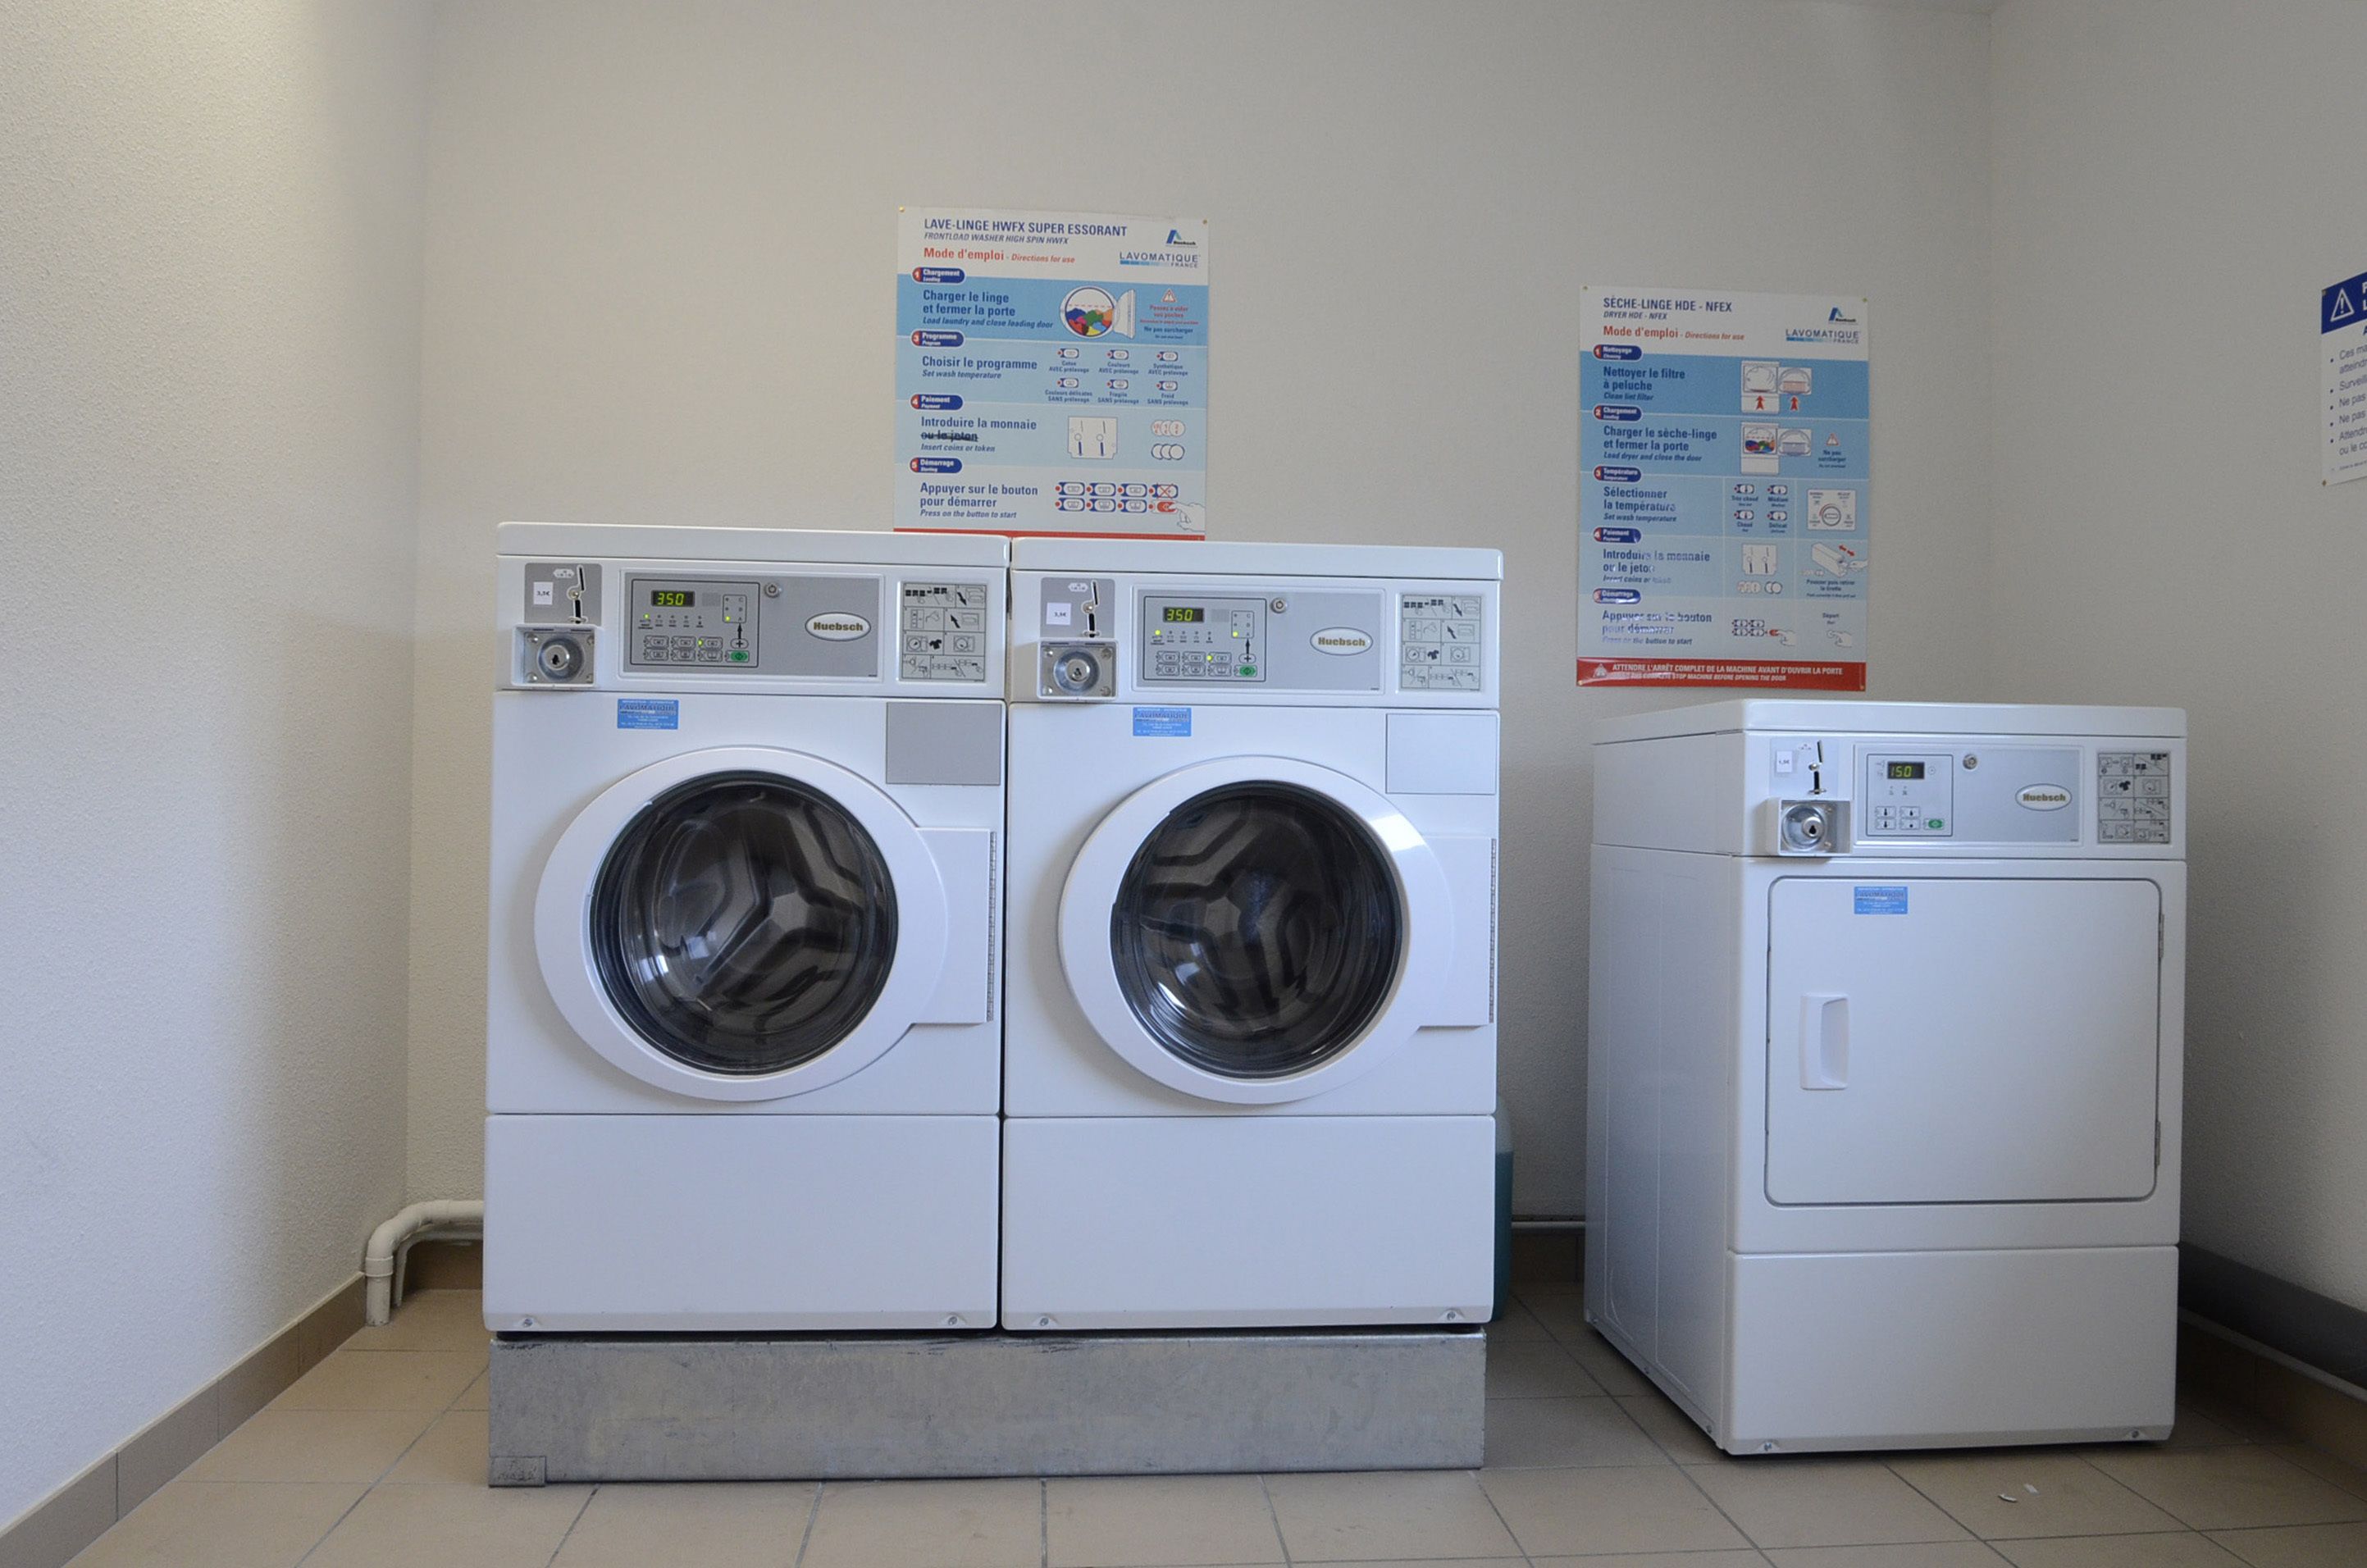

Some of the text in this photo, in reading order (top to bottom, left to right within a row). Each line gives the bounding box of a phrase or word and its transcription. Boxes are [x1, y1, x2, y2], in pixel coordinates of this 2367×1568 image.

[924, 218, 1128, 236] LAVE-LINGE HWFX SUPER ESSORANT
[924, 233, 969, 241] FRONTLOAD
[971, 234, 1004, 242] WASHER
[1006, 235, 1024, 243] HIGH
[924, 248, 955, 258] Mode
[958, 248, 1004, 262] d'emploi
[1011, 253, 1049, 262] Directions
[1051, 255, 1061, 263] for
[1120, 252, 1198, 262] LAVOMATIQUE
[924, 289, 1009, 305] Charger le linge
[1603, 295, 1732, 312] SÈCHE-LINGE HDE NFEX
[923, 303, 1015, 318] et fermer la porte
[1628, 312, 1643, 320] HDE
[923, 317, 941, 325] Load
[942, 317, 969, 326] laundry
[1007, 320, 1035, 328] loading
[1603, 326, 1632, 336] Mode
[1635, 327, 1678, 340] d'emploi
[1685, 331, 1720, 340] Directions
[1786, 329, 1859, 340] LAVOMATIQUE
[2339, 349, 2354, 360] Ces
[922, 356, 1038, 371] Choisir le programme
[922, 369, 934, 377] Set
[957, 371, 1001, 381] temperature
[1603, 366, 1685, 380] Nettoyer le filtre
[1603, 379, 1653, 392] à peluche
[2339, 394, 2365, 407] Ne pas
[921, 416, 1037, 430] Introduire la monnaie
[2339, 410, 2365, 424] Ne pas
[1603, 426, 1717, 441] Charger le sèche-linge
[921, 443, 942, 451] Insert
[1603, 439, 1689, 453] et fermer la porte
[2339, 447, 2349, 456] ou
[1621, 452, 1639, 461] dryer
[920, 482, 1038, 495] Appuyer sur le bouton
[1603, 486, 1667, 499] Sélectionner
[920, 496, 997, 508] pour démarrer
[1603, 499, 1676, 513] la température
[919, 508, 941, 517] Press
[966, 510, 989, 518] button
[1617, 513, 1635, 522] wash
[1635, 515, 1677, 523] temperature
[1654, 549, 1664, 561] la
[1618, 562, 1627, 572] le
[658, 592, 684, 605] 350
[1166, 609, 1193, 622] 350
[1677, 613, 1712, 622] bouton
[814, 622, 864, 631] Huebsch
[1318, 636, 1366, 647] Huebsch
[1758, 666, 1780, 674] AVANT
[1822, 668, 1843, 676] PORTE
[2023, 794, 2066, 802] Huebsch
